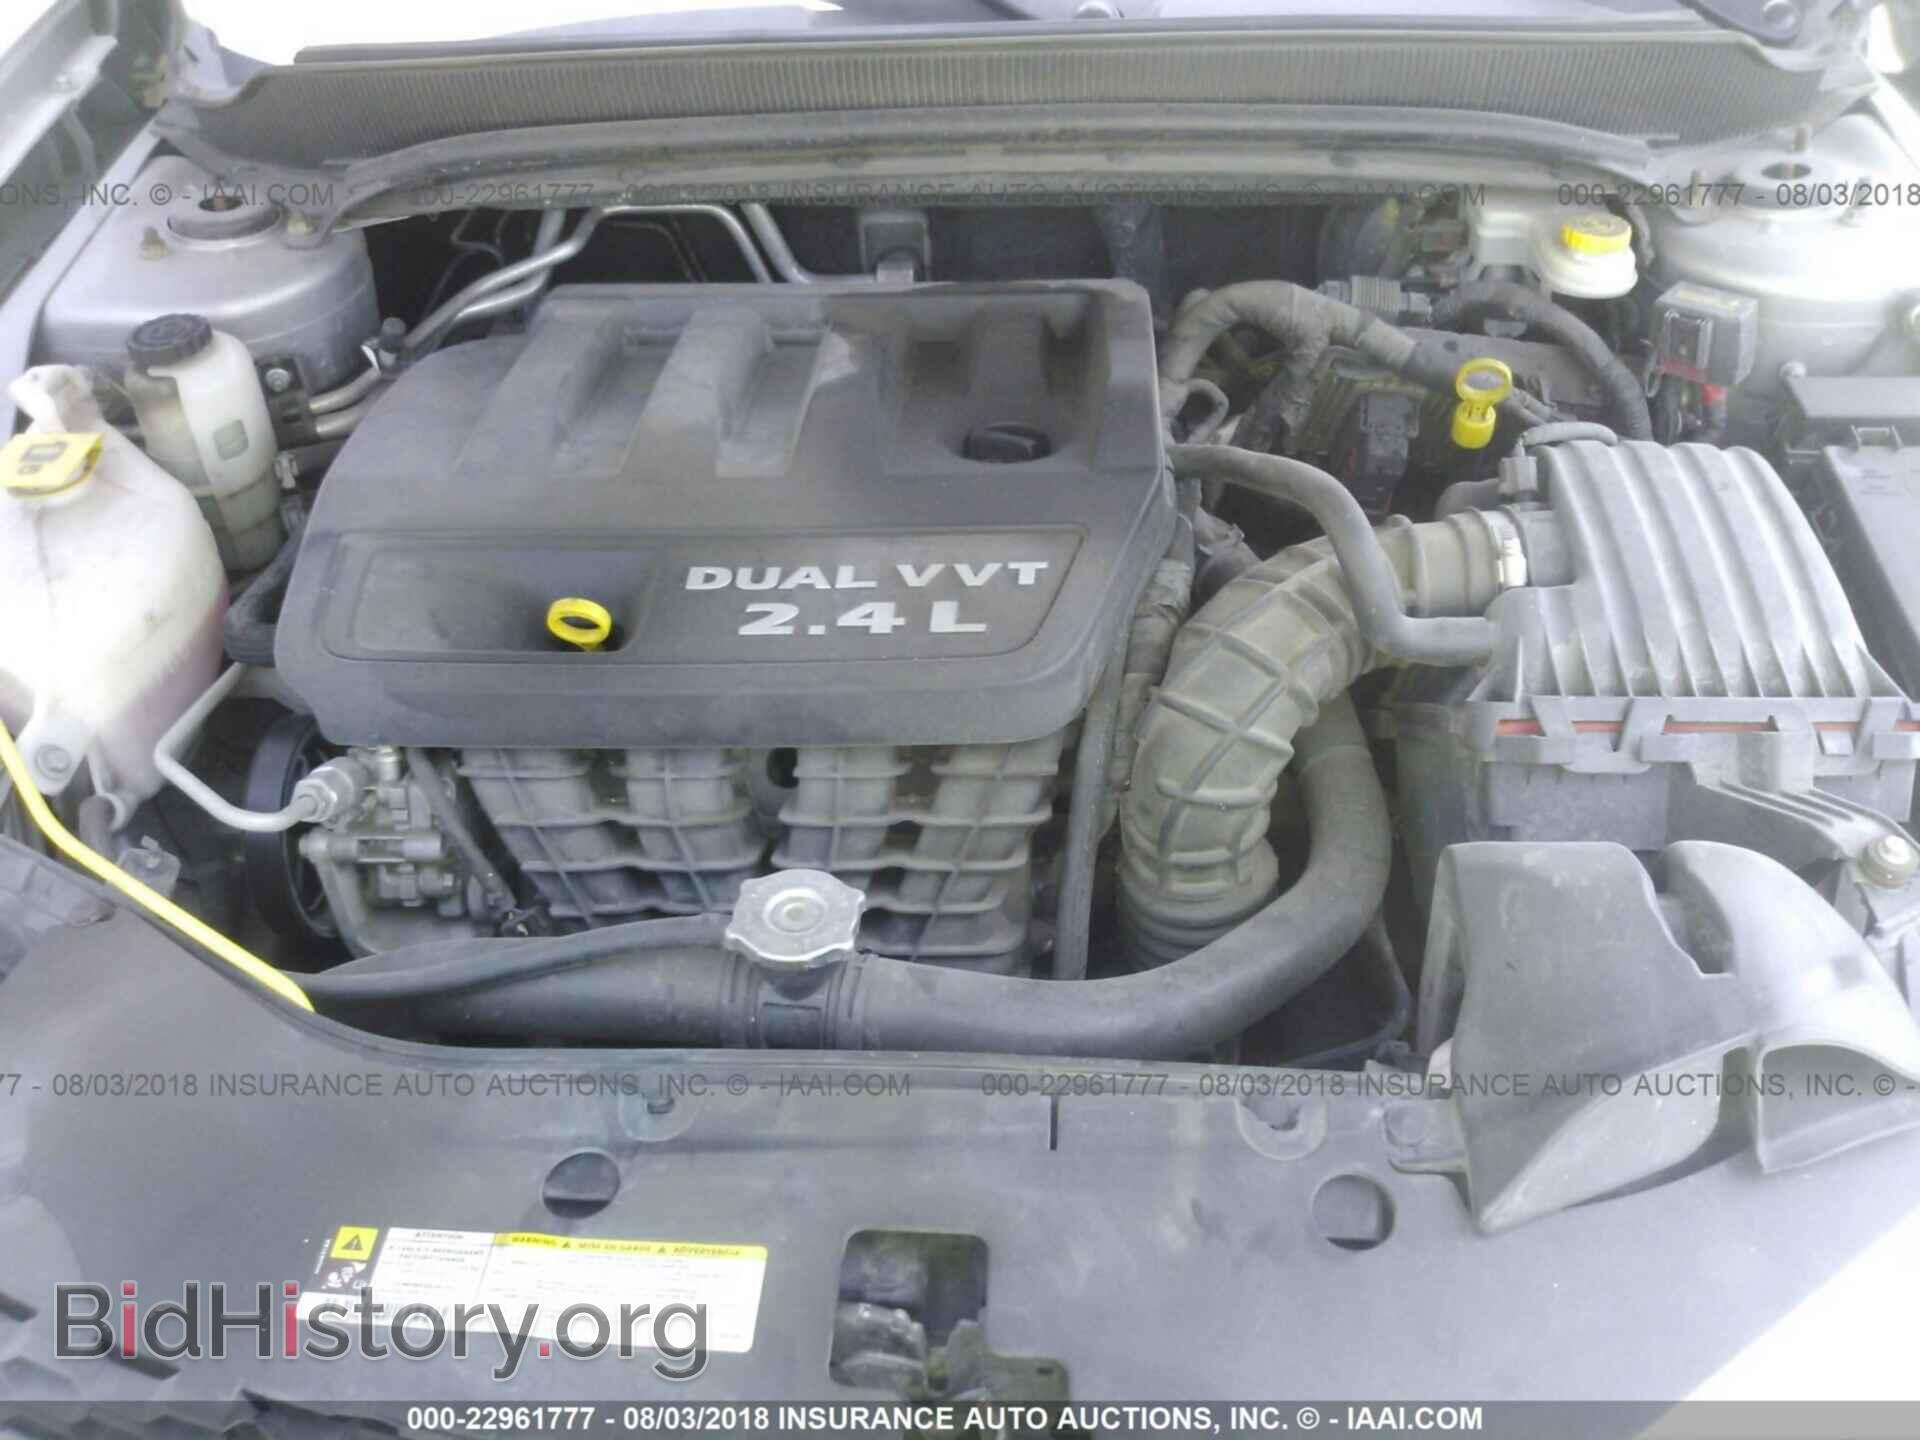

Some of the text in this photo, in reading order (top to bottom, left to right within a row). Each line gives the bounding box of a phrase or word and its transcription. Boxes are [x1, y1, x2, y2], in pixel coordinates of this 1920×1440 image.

[685, 562, 1049, 590] DUAL VVT
[738, 600, 988, 636] 2.4 L
